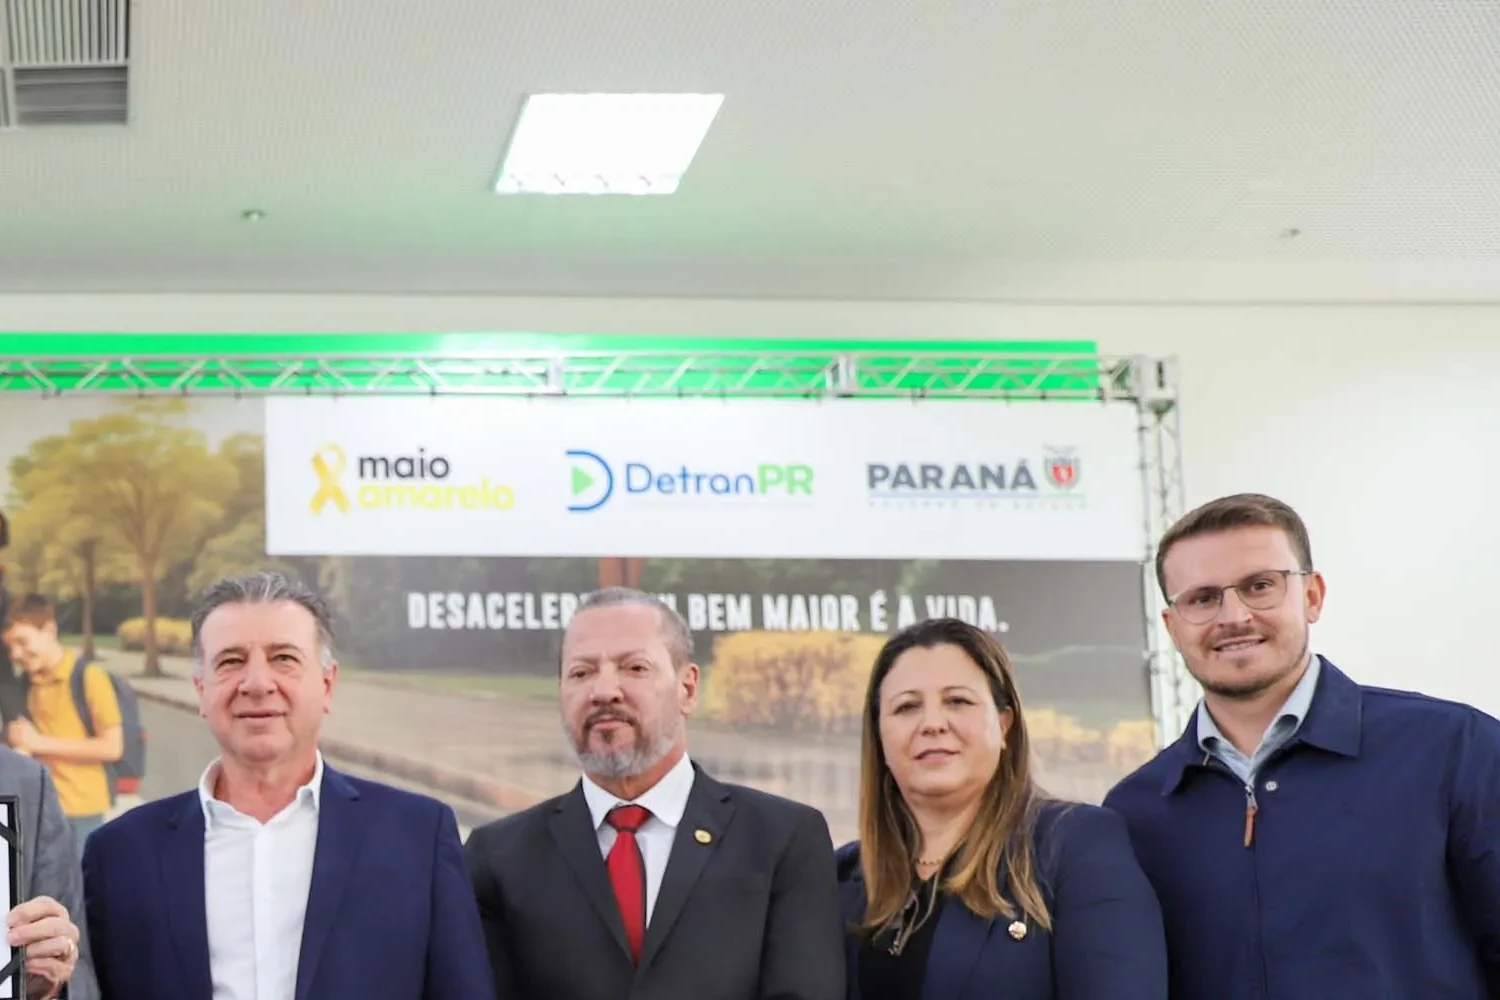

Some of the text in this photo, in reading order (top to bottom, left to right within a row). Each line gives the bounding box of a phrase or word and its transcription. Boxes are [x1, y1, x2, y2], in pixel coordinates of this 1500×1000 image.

[357, 447, 450, 479] maio
[625, 463, 815, 495] DetranPR
[866, 458, 1038, 490] PARANÁ
[357, 477, 516, 510] amarelo
[688, 593, 753, 631] BEM
[761, 593, 861, 632] MAIOR
[869, 589, 888, 632] É
[897, 594, 918, 630] A
